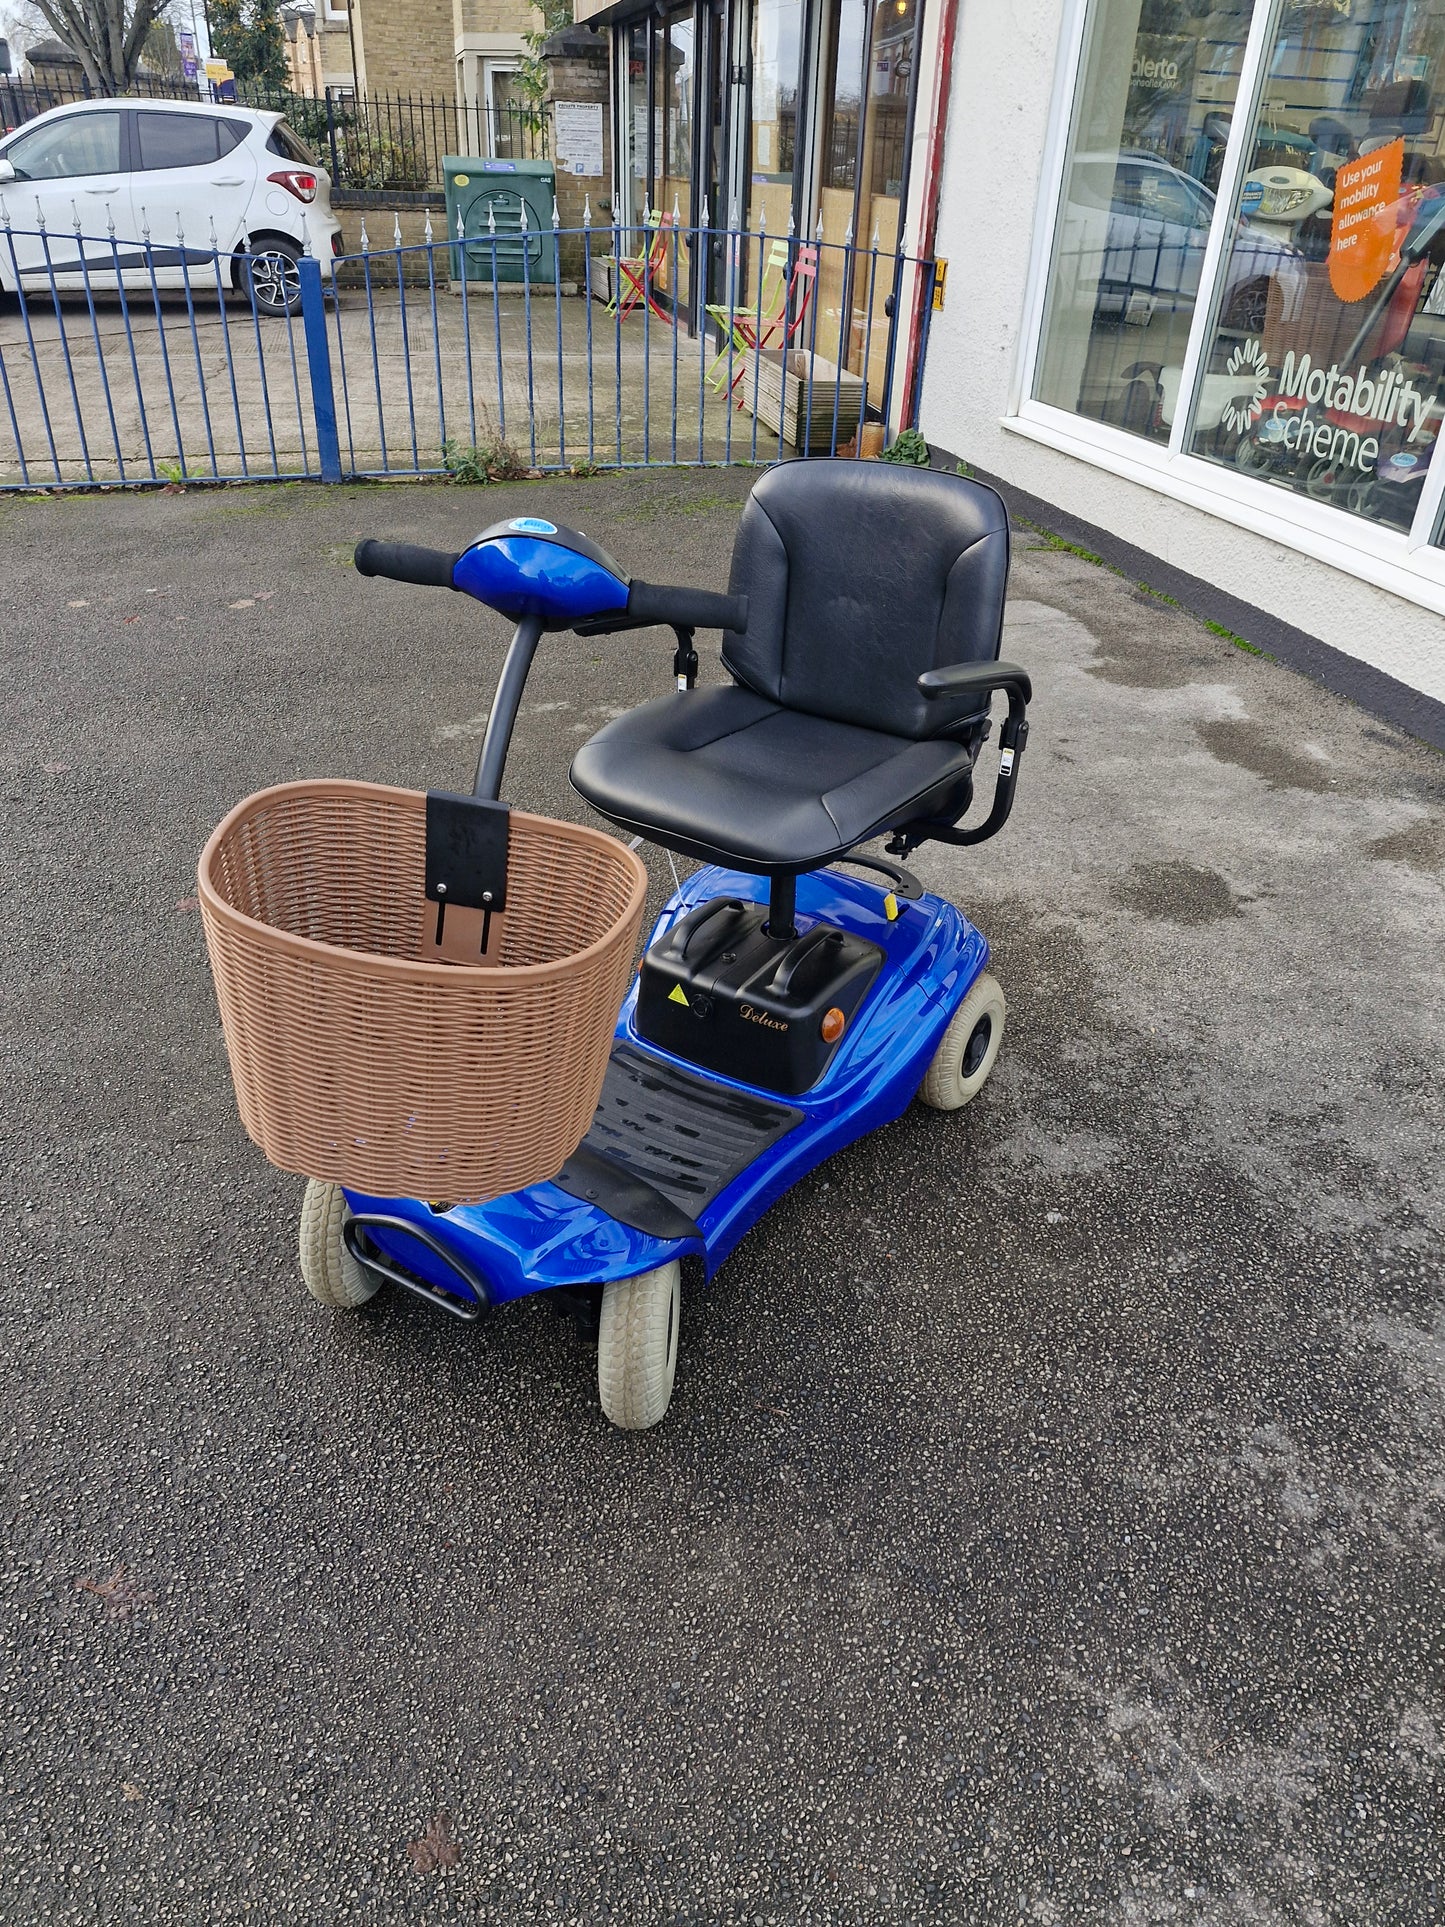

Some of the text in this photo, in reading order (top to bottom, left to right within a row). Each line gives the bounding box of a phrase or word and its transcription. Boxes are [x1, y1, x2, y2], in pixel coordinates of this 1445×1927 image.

[1130, 55, 1178, 80] alerta
[1342, 160, 1383, 188] Use your
[1340, 182, 1380, 209] mobility
[1338, 201, 1386, 230] allowance
[1336, 234, 1358, 251] here
[1278, 350, 1437, 443] Motability
[1273, 401, 1379, 473] Scheme
[740, 1003, 789, 1032] Deluxe
